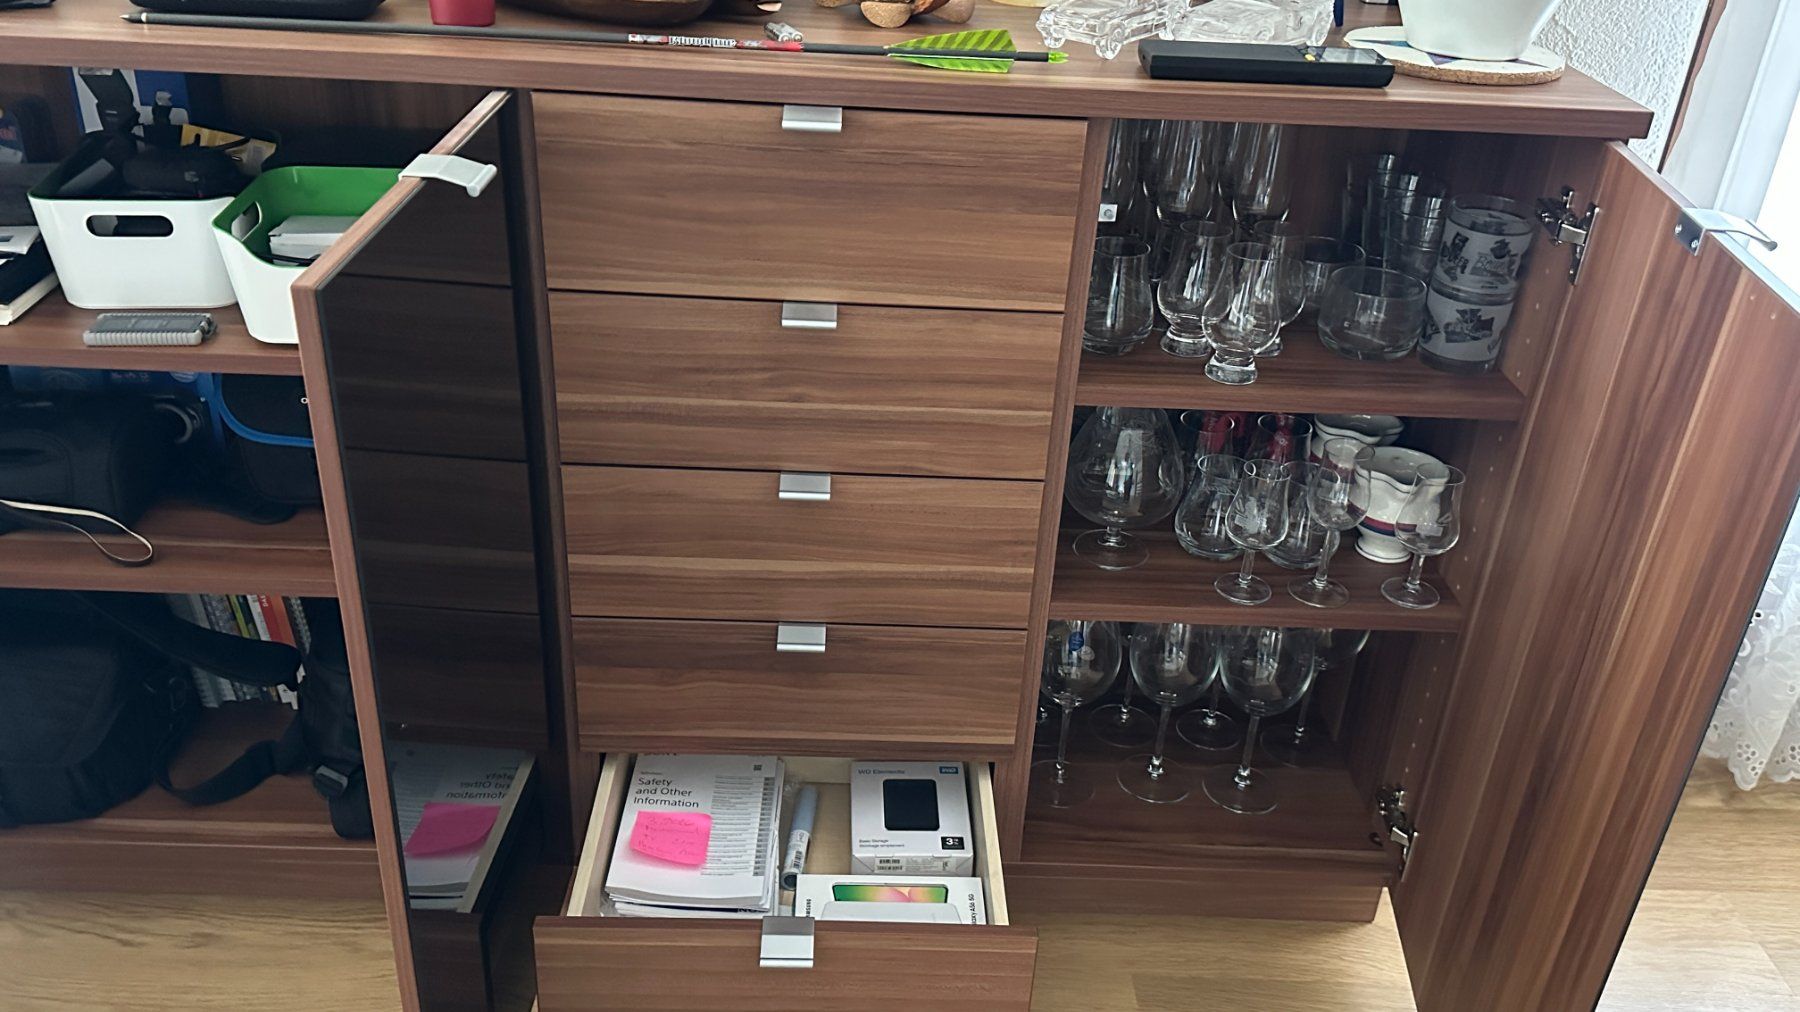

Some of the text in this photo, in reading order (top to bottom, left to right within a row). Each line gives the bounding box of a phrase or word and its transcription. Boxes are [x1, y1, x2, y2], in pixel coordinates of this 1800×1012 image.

[638, 777, 672, 787] Safety
[635, 787, 693, 798] and Other
[633, 796, 699, 808] Information
[945, 837, 953, 845] 3
